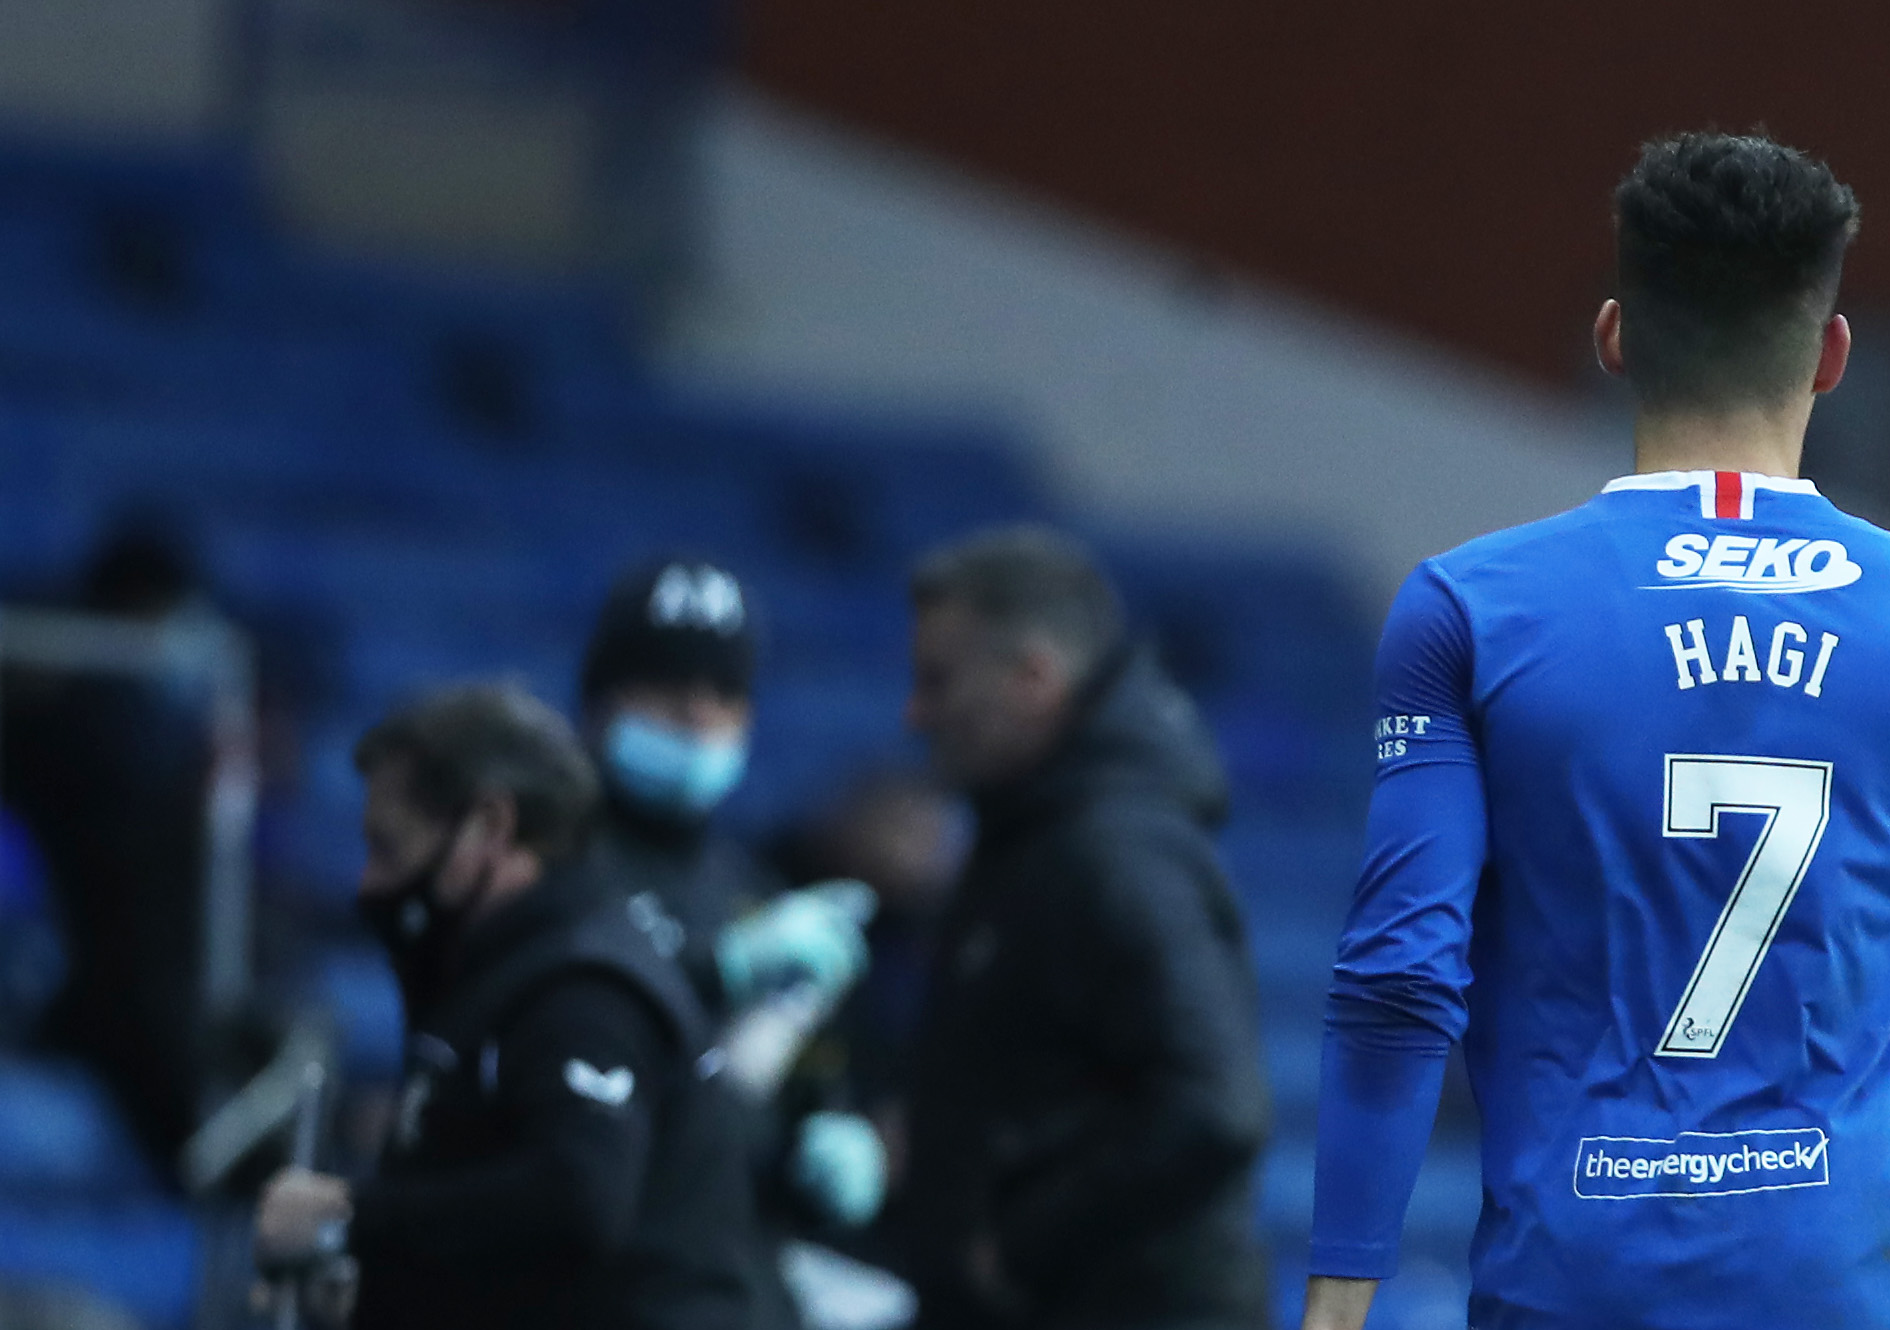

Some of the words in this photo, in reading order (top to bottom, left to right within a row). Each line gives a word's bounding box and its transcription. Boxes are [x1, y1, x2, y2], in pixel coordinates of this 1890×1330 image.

[1656, 533, 1860, 584] SEKO
[1664, 615, 1840, 698] HAGI
[1655, 752, 1834, 1059] 7
[1690, 1027, 1715, 1038] SPFL
